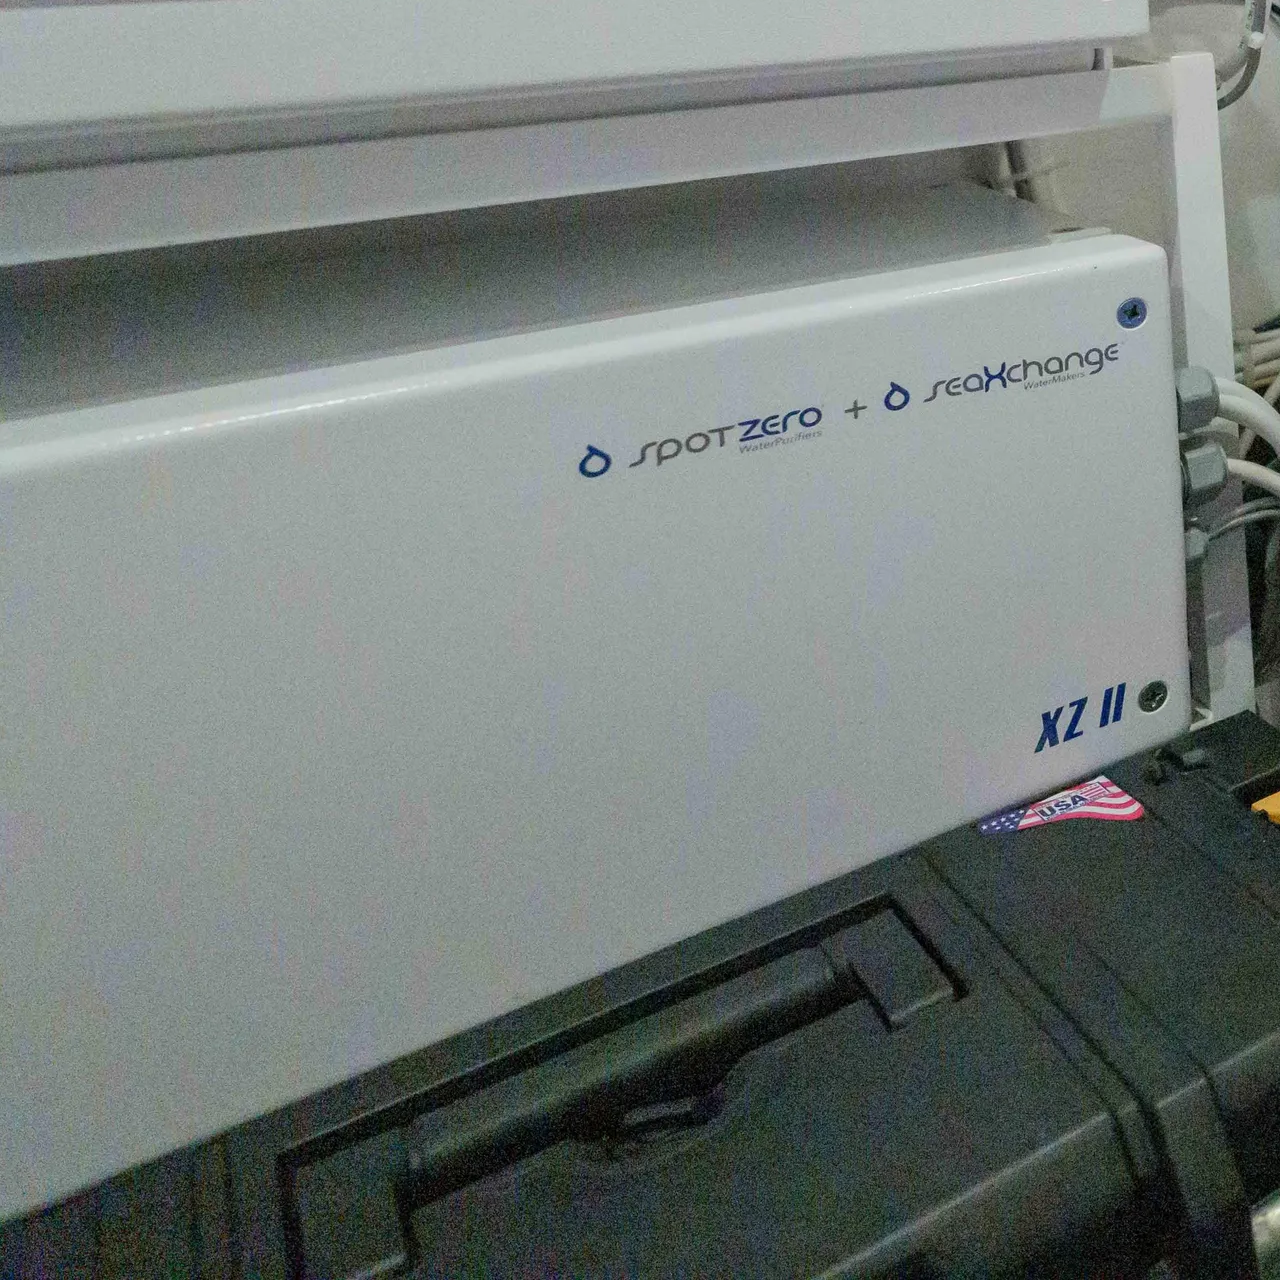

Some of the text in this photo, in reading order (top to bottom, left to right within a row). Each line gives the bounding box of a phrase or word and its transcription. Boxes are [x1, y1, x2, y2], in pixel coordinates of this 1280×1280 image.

[1023, 370, 1086, 392] WaterMakers
[1033, 681, 1127, 754] XZ II
[1038, 794, 1090, 818] USA
